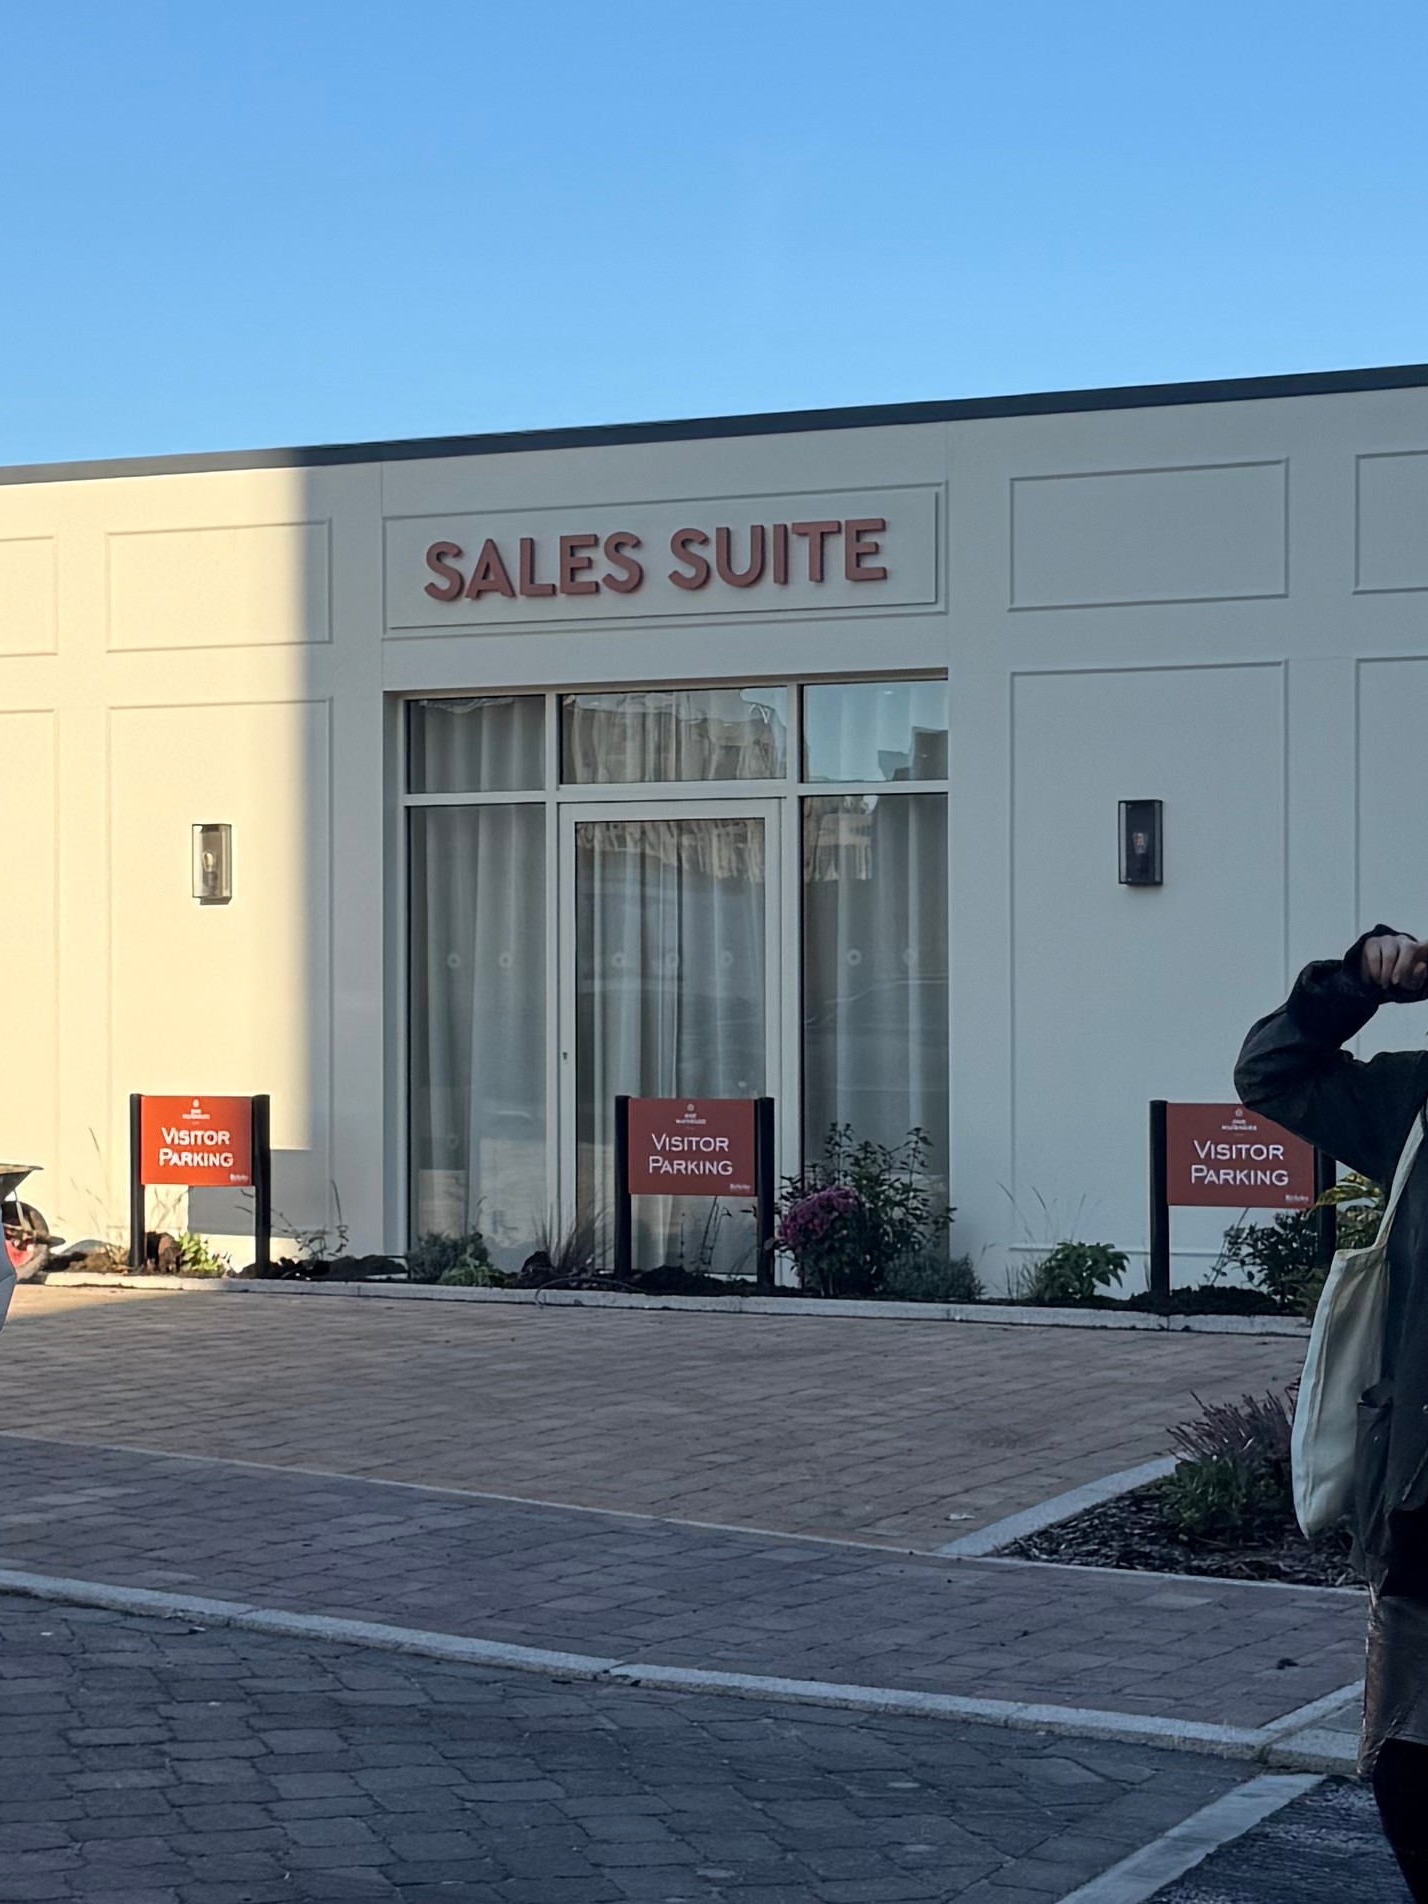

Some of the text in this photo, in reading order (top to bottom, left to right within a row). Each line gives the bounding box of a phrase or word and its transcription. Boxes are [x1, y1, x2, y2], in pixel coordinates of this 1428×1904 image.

[424, 518, 888, 602] SALES SUITE
[161, 1127, 230, 1146] VISITOR
[651, 1133, 729, 1153] VISITOR
[159, 1148, 234, 1168] PARKING
[1193, 1139, 1284, 1161] VISITOR
[649, 1155, 733, 1176] PARKING
[1191, 1165, 1289, 1186] PARKING
